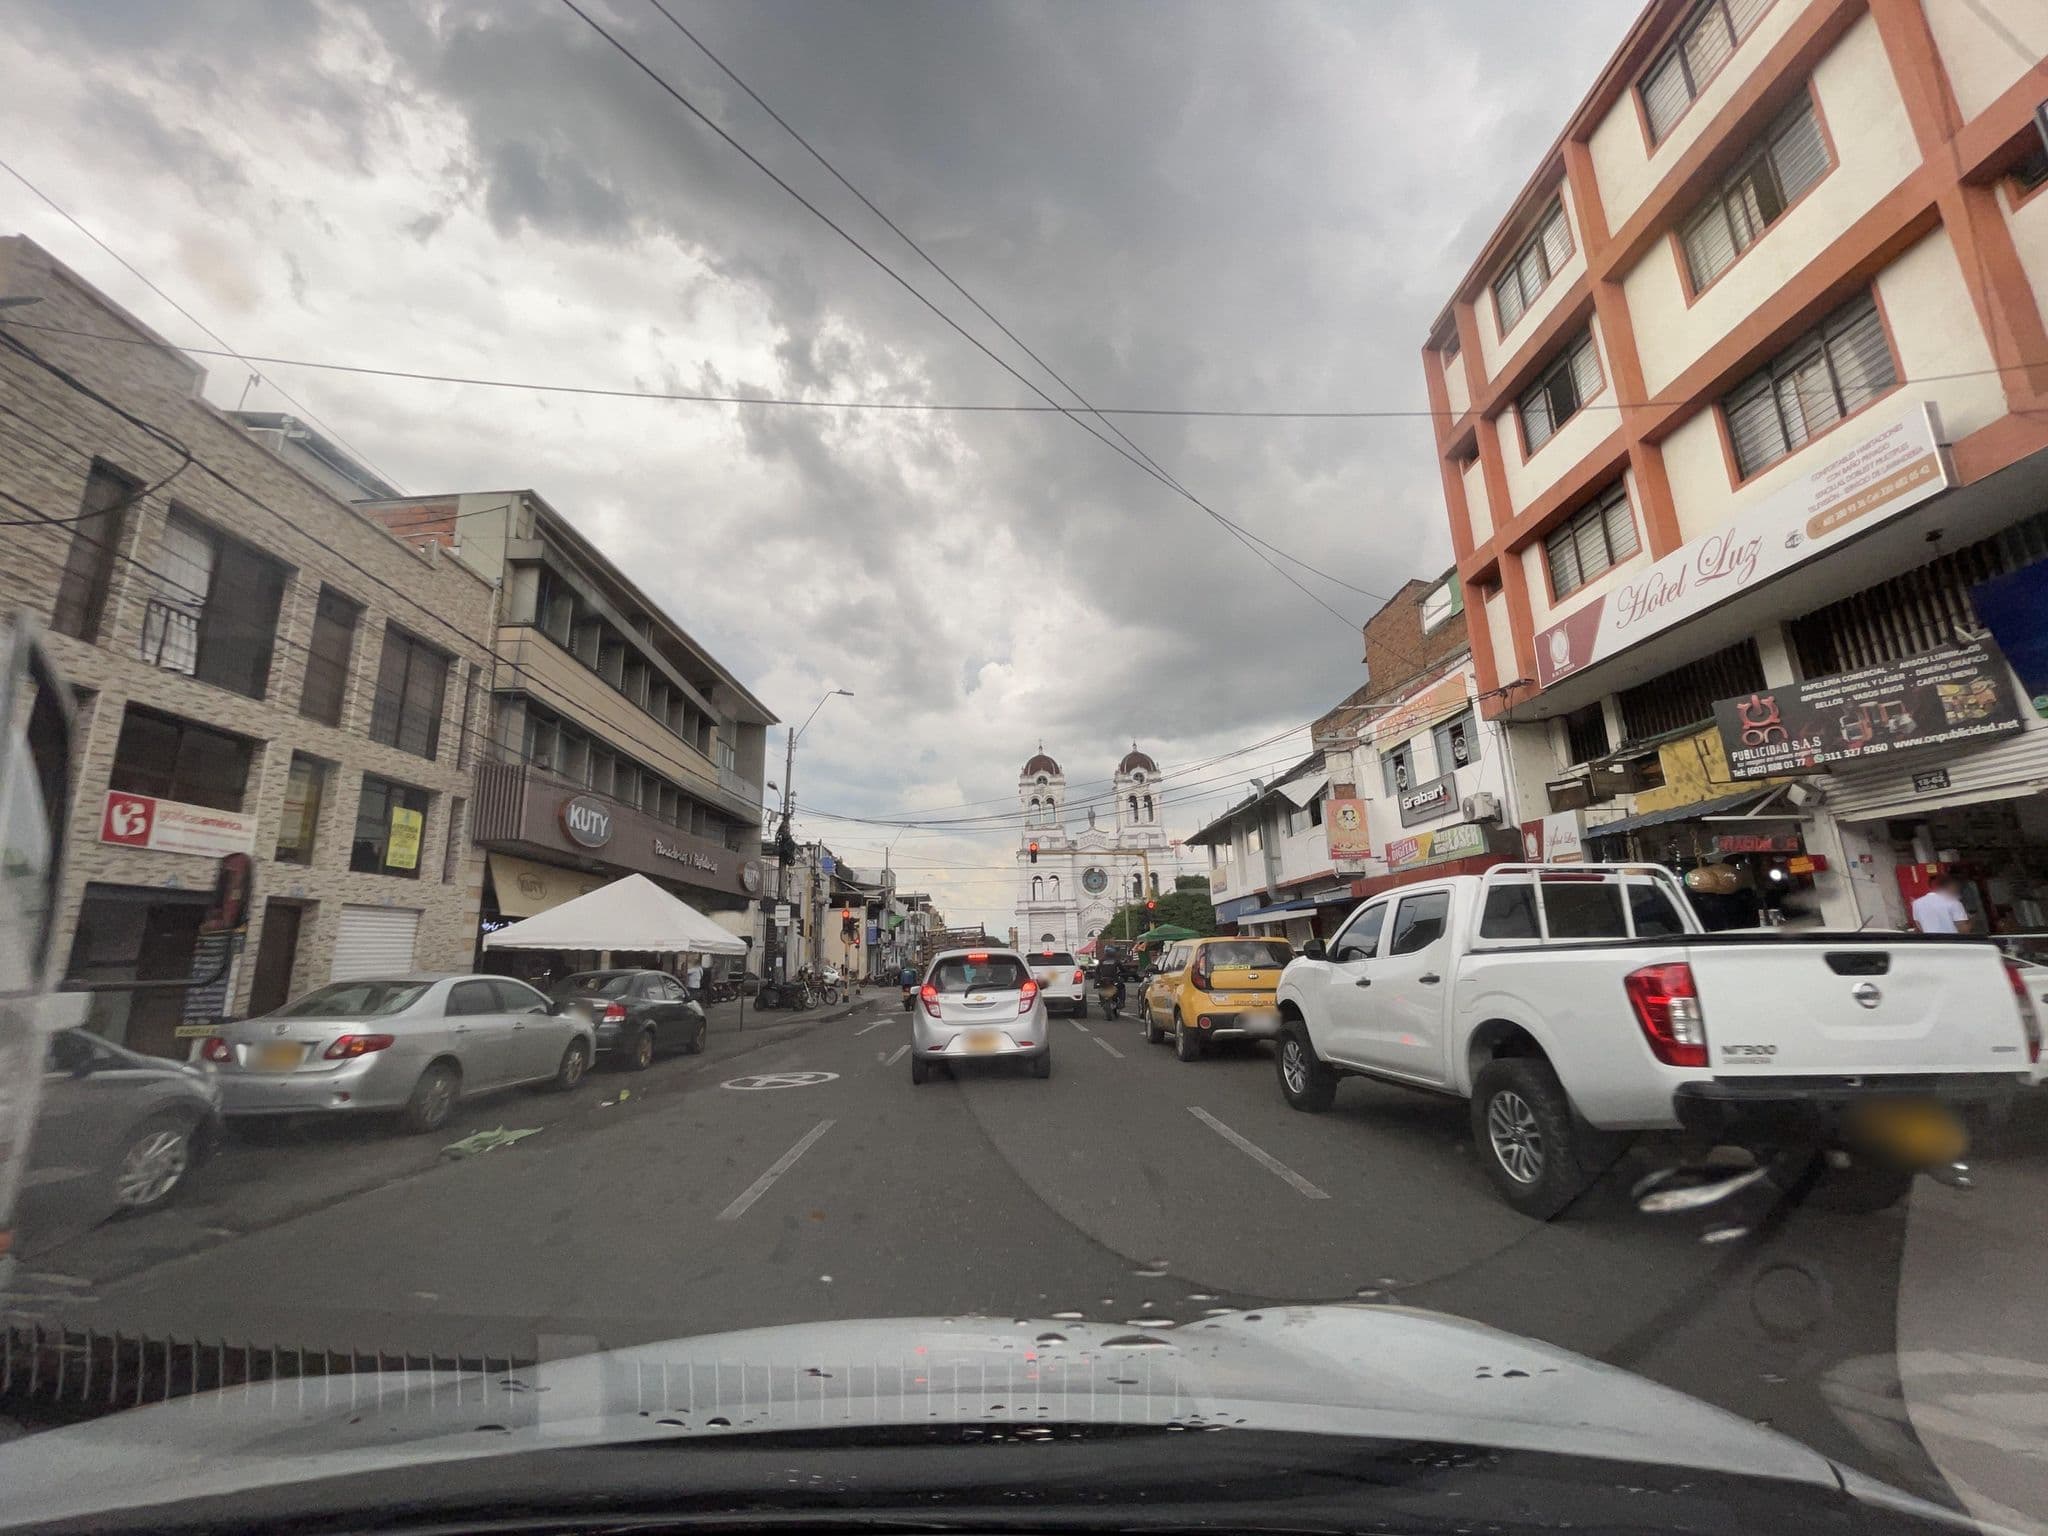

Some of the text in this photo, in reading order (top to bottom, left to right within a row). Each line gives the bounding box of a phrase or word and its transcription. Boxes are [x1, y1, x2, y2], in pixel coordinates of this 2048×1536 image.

[1616, 527, 1764, 629] Hotel Luz
[1841, 667, 1888, 683] COMERCIAL
[1841, 681, 1872, 694] DIGITAL
[1815, 697, 1844, 709] SELLOS
[1852, 690, 1880, 701] VASOS
[1880, 684, 1905, 695] MUGS
[1917, 673, 1951, 687] CARTAS
[1731, 736, 1822, 762] PUBLICIDAD S.A.S
[1747, 764, 1768, 776] (602)
[1783, 760, 1795, 769] 01
[1823, 750, 1842, 762] 311
[1843, 747, 1861, 759] 327
[1863, 742, 1889, 755] 9260
[1892, 719, 2020, 750] www.onpublicidad.net
[1402, 784, 1445, 810] Grabart
[569, 804, 609, 837] KUTY
[1392, 838, 1418, 861] DIGITAL
